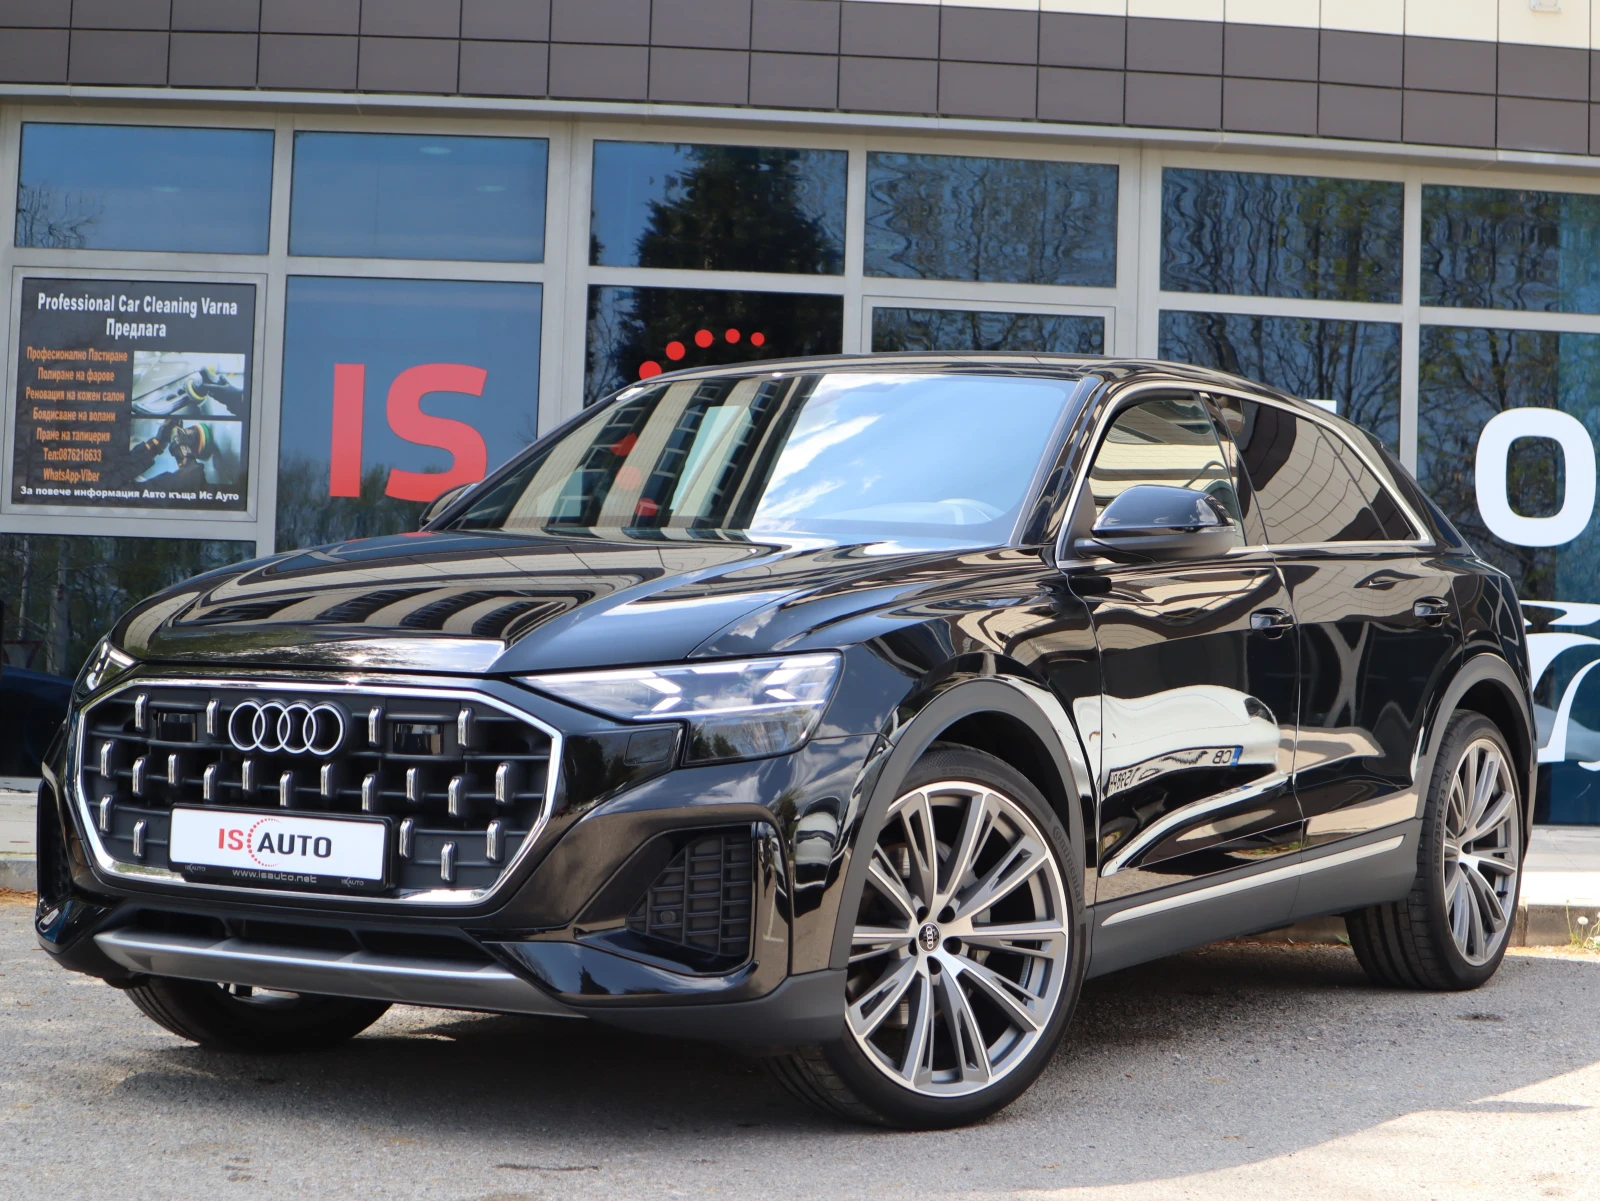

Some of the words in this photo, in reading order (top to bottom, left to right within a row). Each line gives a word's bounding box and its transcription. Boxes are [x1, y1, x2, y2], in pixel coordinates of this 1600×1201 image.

[38, 293, 115, 312] Professional
[118, 296, 140, 312] Car
[144, 296, 198, 318] Cleaning
[201, 298, 238, 315] Varna
[106, 318, 167, 340] Предлага
[26, 346, 86, 362] Професионално
[88, 348, 128, 364] Пастиране
[38, 366, 74, 382] Полиране
[76, 370, 85, 380] на
[86, 368, 114, 384] фарове
[26, 386, 64, 402] Реновация
[66, 390, 75, 400] на
[77, 391, 100, 401] кожен
[102, 392, 125, 402] салон
[33, 406, 76, 422] Боядисване
[78, 412, 87, 420] на
[89, 412, 116, 422] волани
[36, 427, 59, 443] Пране
[61, 431, 70, 440] на
[72, 432, 110, 444] тапицерия
[329, 362, 488, 502] IS
[43, 468, 99, 484] WhatsApp-Viber
[20, 486, 32, 495] За
[36, 488, 71, 496] повече
[74, 488, 140, 499] информация
[142, 489, 166, 499] Авто
[169, 492, 196, 500] къща
[199, 490, 213, 500] Ис
[215, 491, 239, 502] Ауто
[218, 828, 244, 850] IS
[257, 832, 332, 858] AUTO
[232, 869, 317, 884] www.isauto.net
